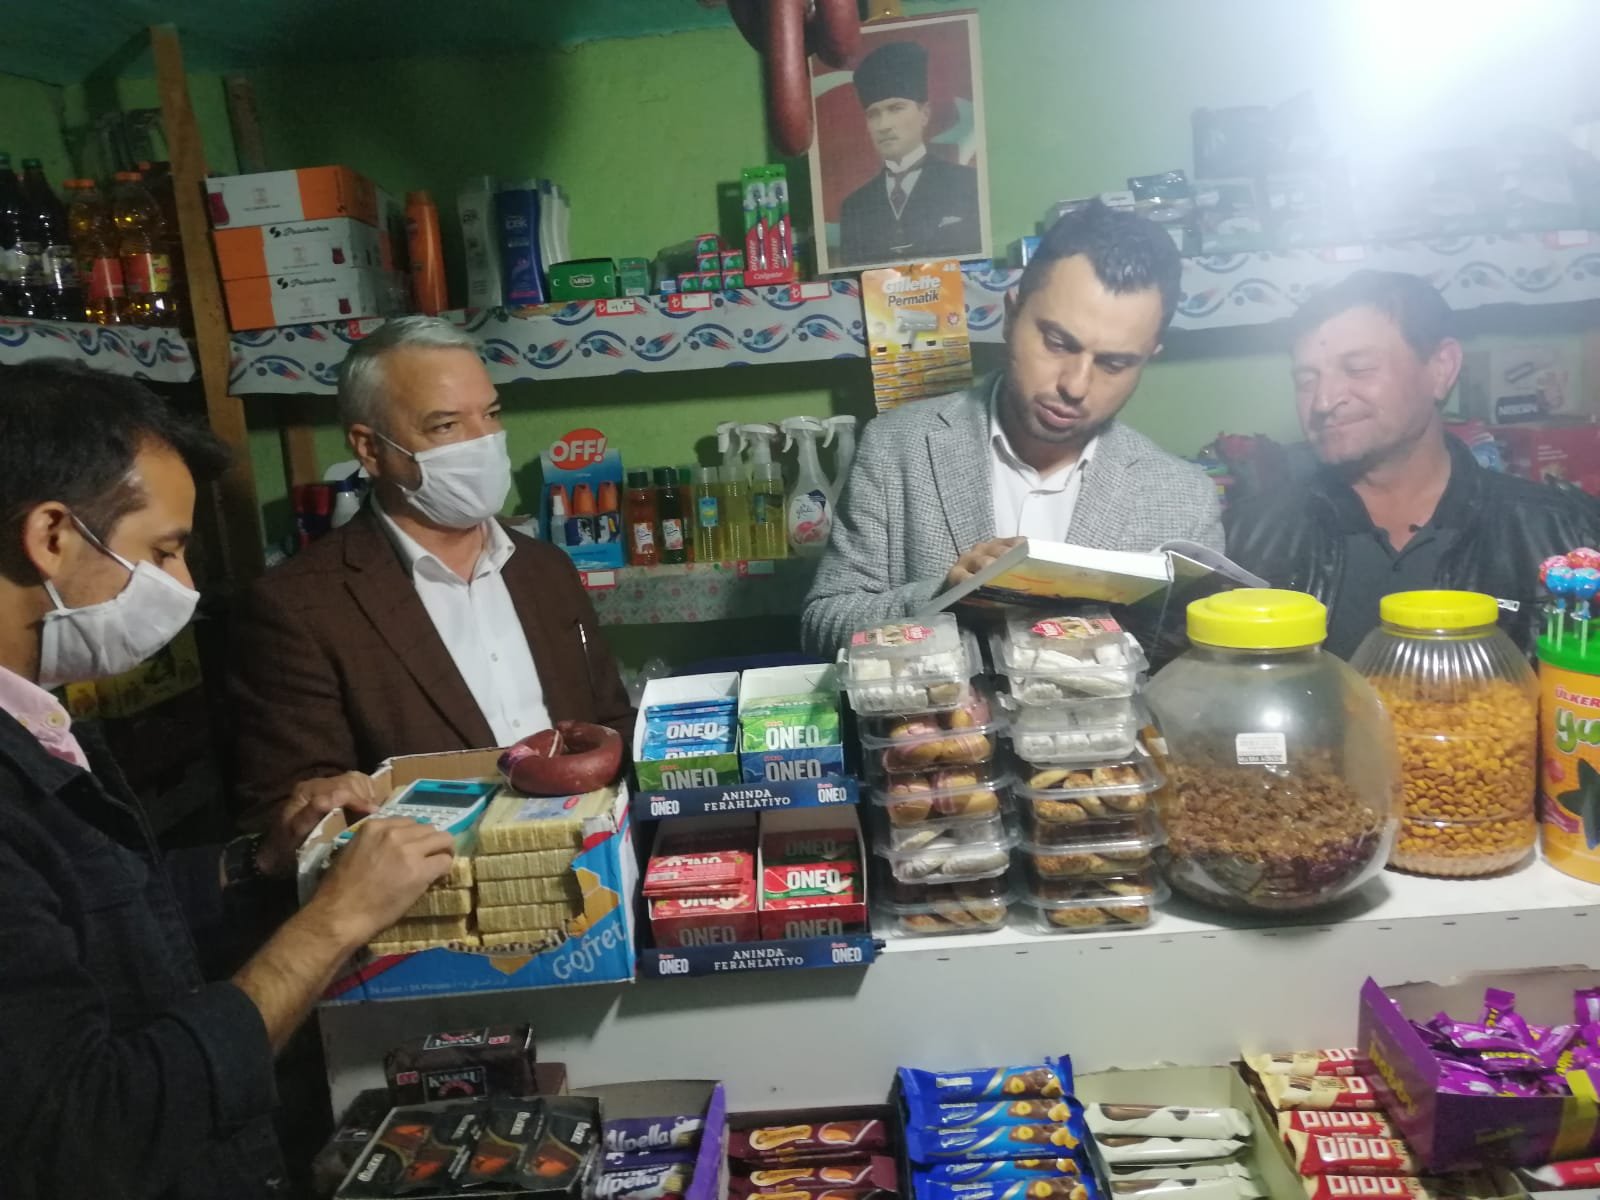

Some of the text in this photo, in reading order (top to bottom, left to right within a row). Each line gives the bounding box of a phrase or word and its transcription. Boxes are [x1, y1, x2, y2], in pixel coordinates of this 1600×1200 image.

[888, 289, 939, 307] Permatik
[550, 437, 607, 462] OFF!
[666, 721, 718, 740] ONEO
[765, 725, 820, 750] ONEO
[661, 767, 719, 790] ONEO
[765, 759, 822, 782] ONEO
[721, 788, 773, 801] ANINDA
[818, 787, 847, 803] ONEO
[650, 800, 680, 816] ONEO
[786, 868, 841, 889] ONEO
[679, 925, 738, 947] ONEO
[785, 918, 843, 939] ONEO
[552, 919, 627, 980] Gofret
[732, 948, 785, 960] ANINDA
[831, 946, 863, 964] ONEO
[658, 958, 690, 976] ONEO
